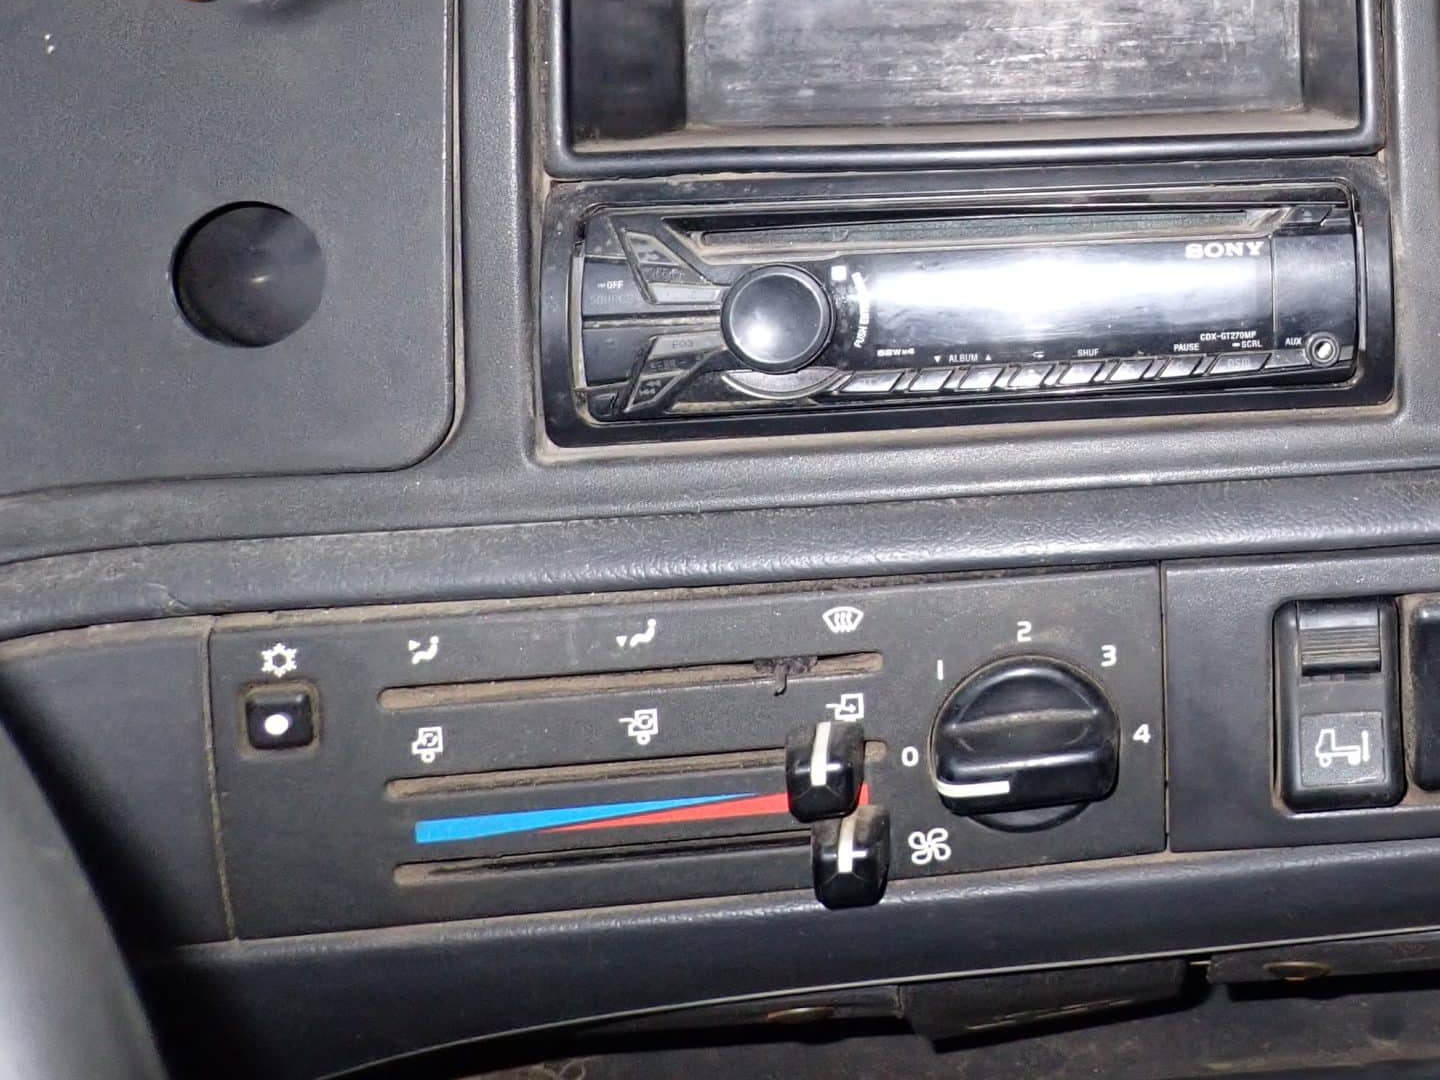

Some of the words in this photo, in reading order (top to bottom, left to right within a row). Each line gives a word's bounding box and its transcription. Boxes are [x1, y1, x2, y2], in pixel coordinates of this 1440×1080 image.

[1184, 240, 1265, 259] SONY
[1173, 341, 1200, 353] PAUSE
[1285, 337, 1303, 347] AUX
[948, 353, 979, 364] ALBUM
[1077, 348, 1100, 358] SHUF
[1016, 620, 1033, 642] 2
[1100, 644, 1118, 667] 3
[1132, 723, 1152, 744] 4
[901, 746, 920, 768] 0
